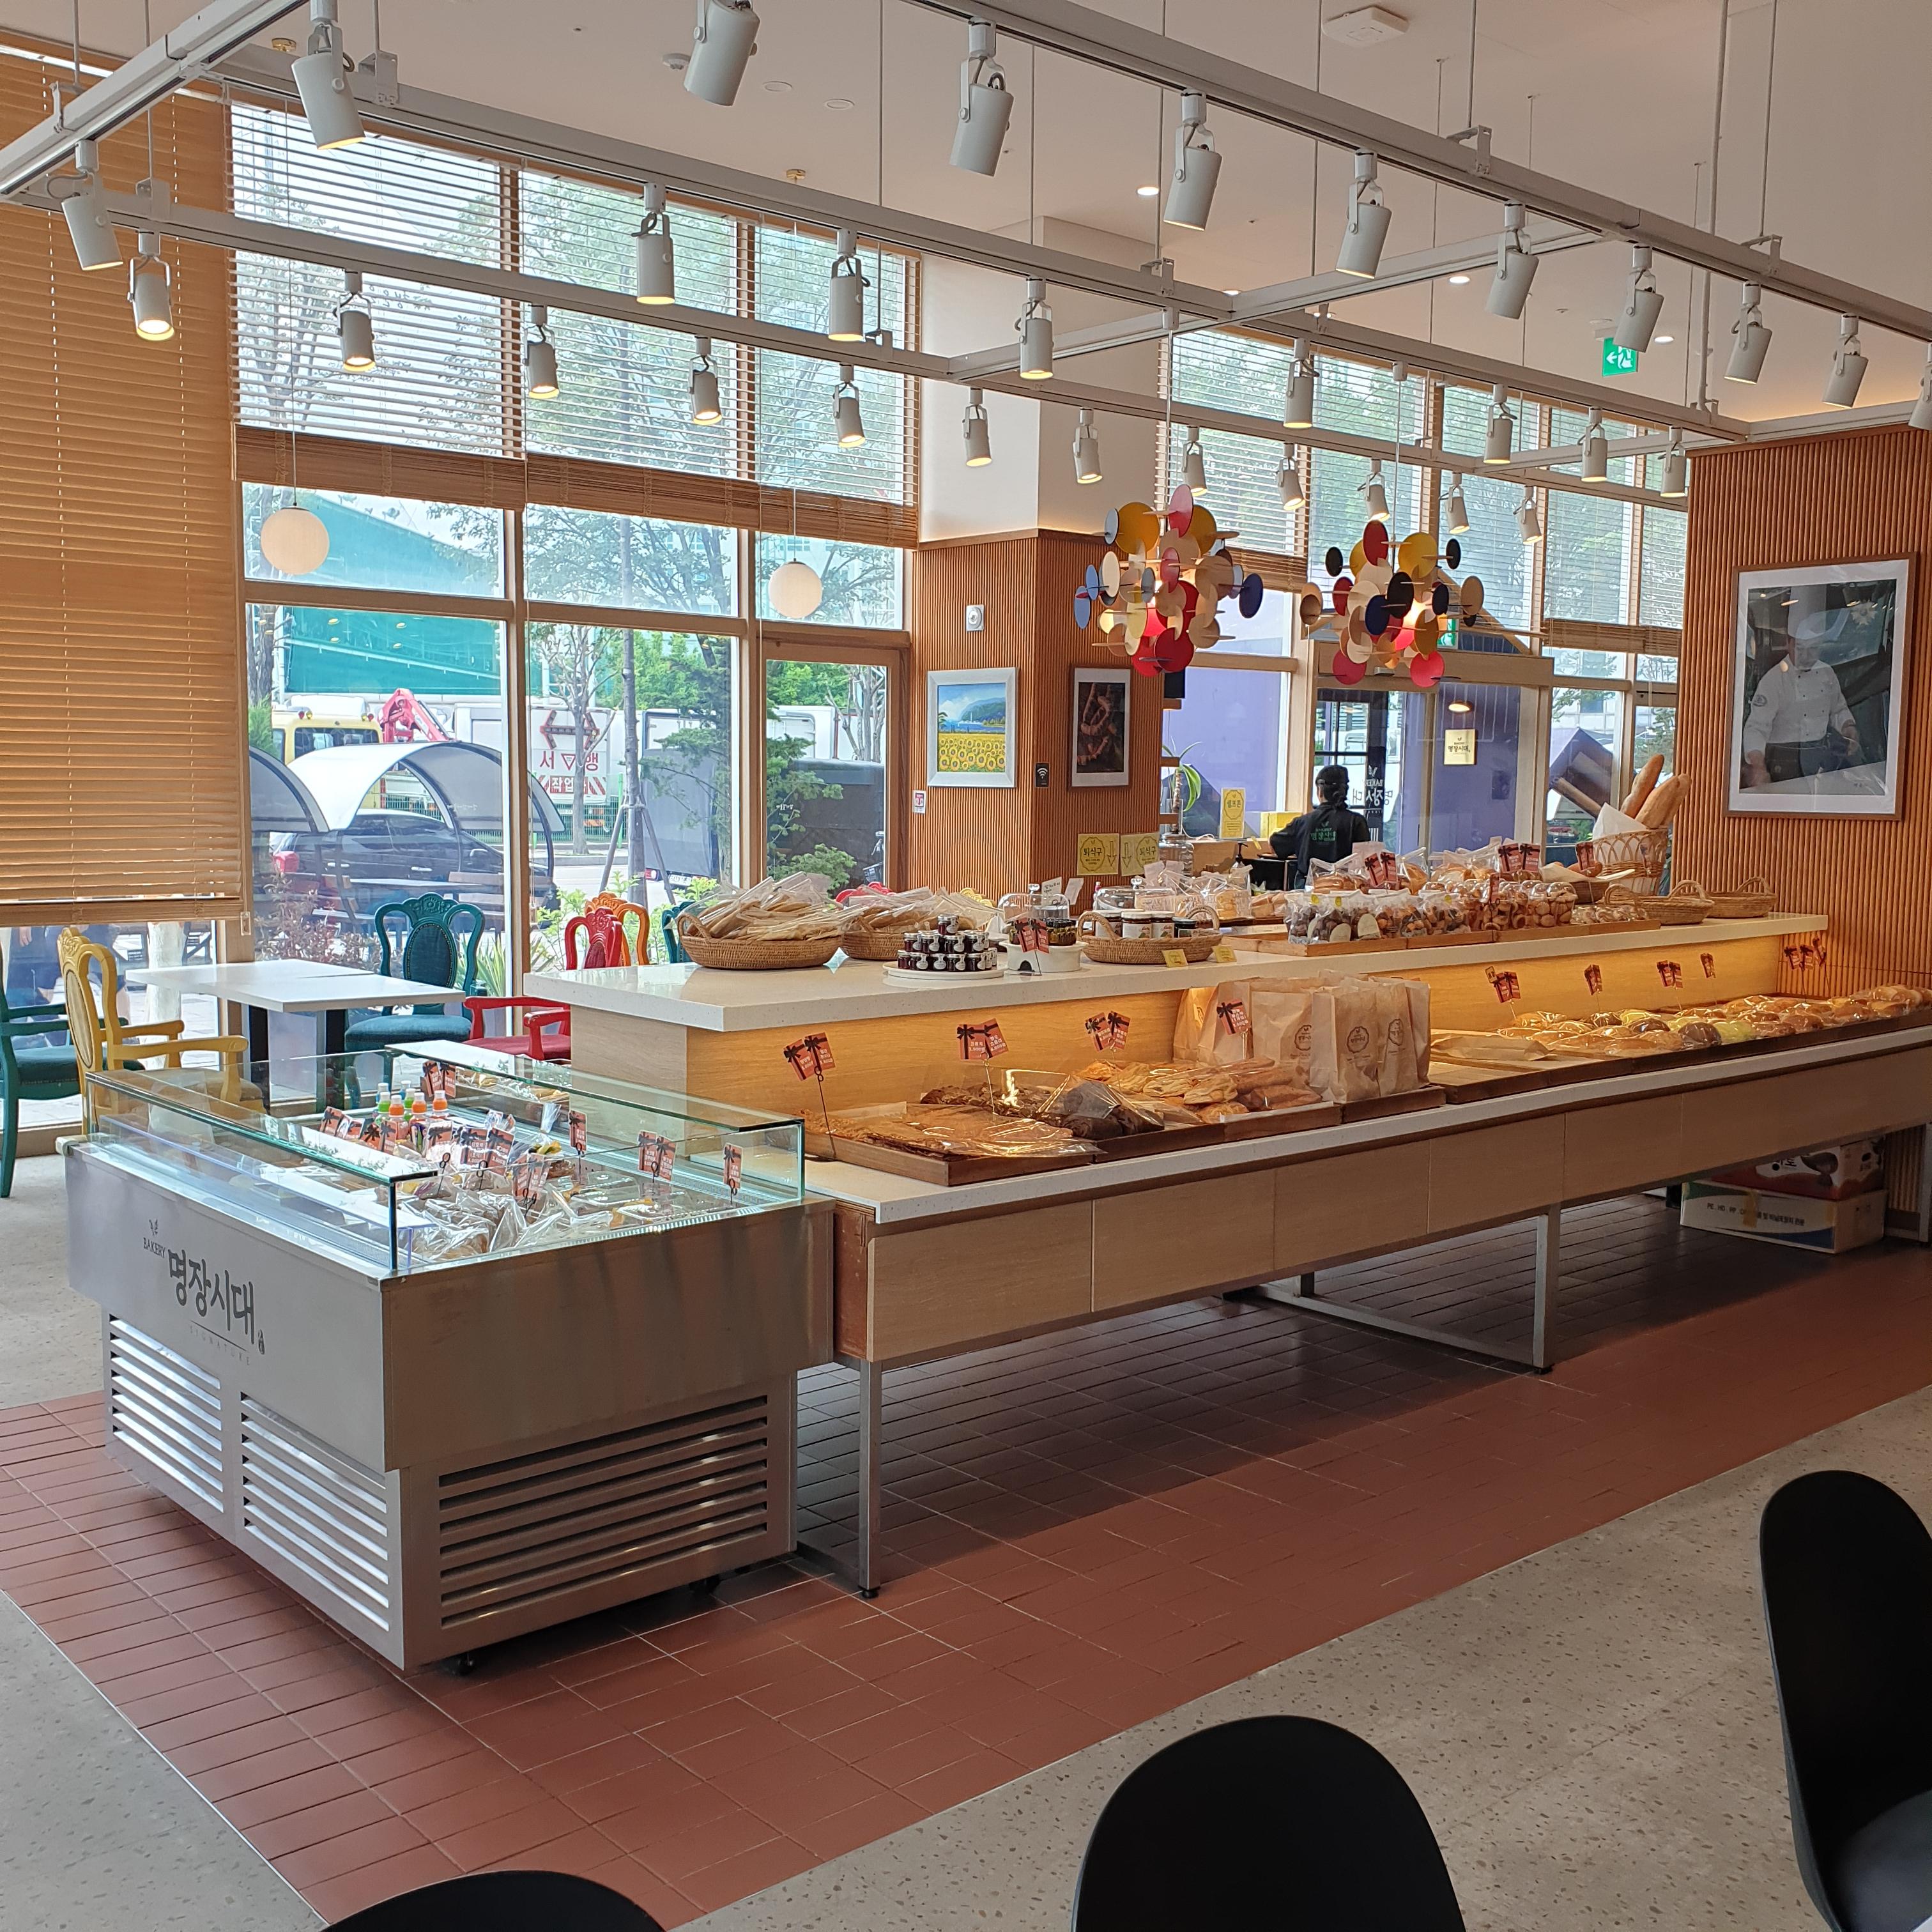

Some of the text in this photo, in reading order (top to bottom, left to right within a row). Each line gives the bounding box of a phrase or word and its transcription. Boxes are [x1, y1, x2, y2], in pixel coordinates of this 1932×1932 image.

[540, 751, 599, 770] 서 행
[1084, 847, 1102, 857] 퇴식구
[1139, 846, 1157, 856] 퇴식구
[143, 1237, 165, 1259] BAKERY
[168, 1249, 254, 1344] 명장시대
